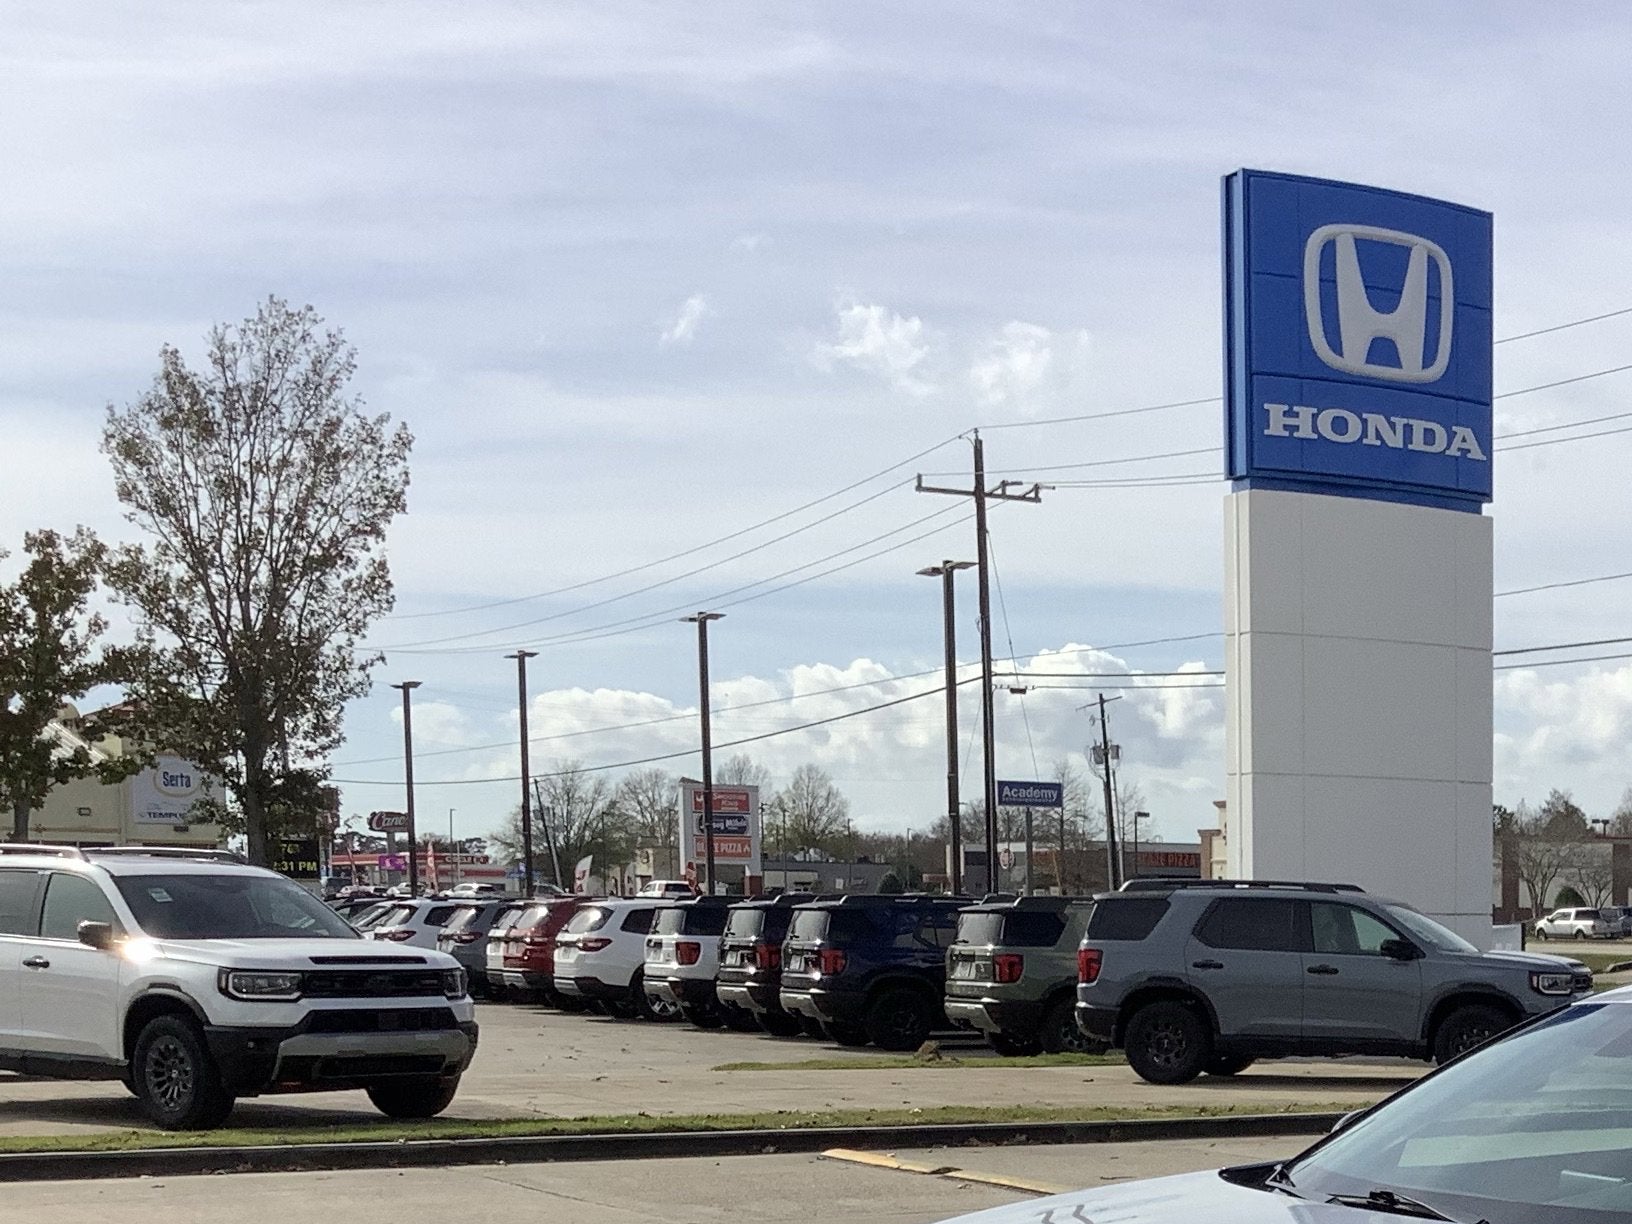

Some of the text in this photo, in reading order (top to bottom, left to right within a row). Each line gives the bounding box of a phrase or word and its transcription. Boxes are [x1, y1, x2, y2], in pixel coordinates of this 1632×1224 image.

[1263, 403, 1487, 461] HONDA
[162, 771, 191, 788] Serta
[1002, 785, 1058, 802] Academy
[298, 861, 318, 872] PM
